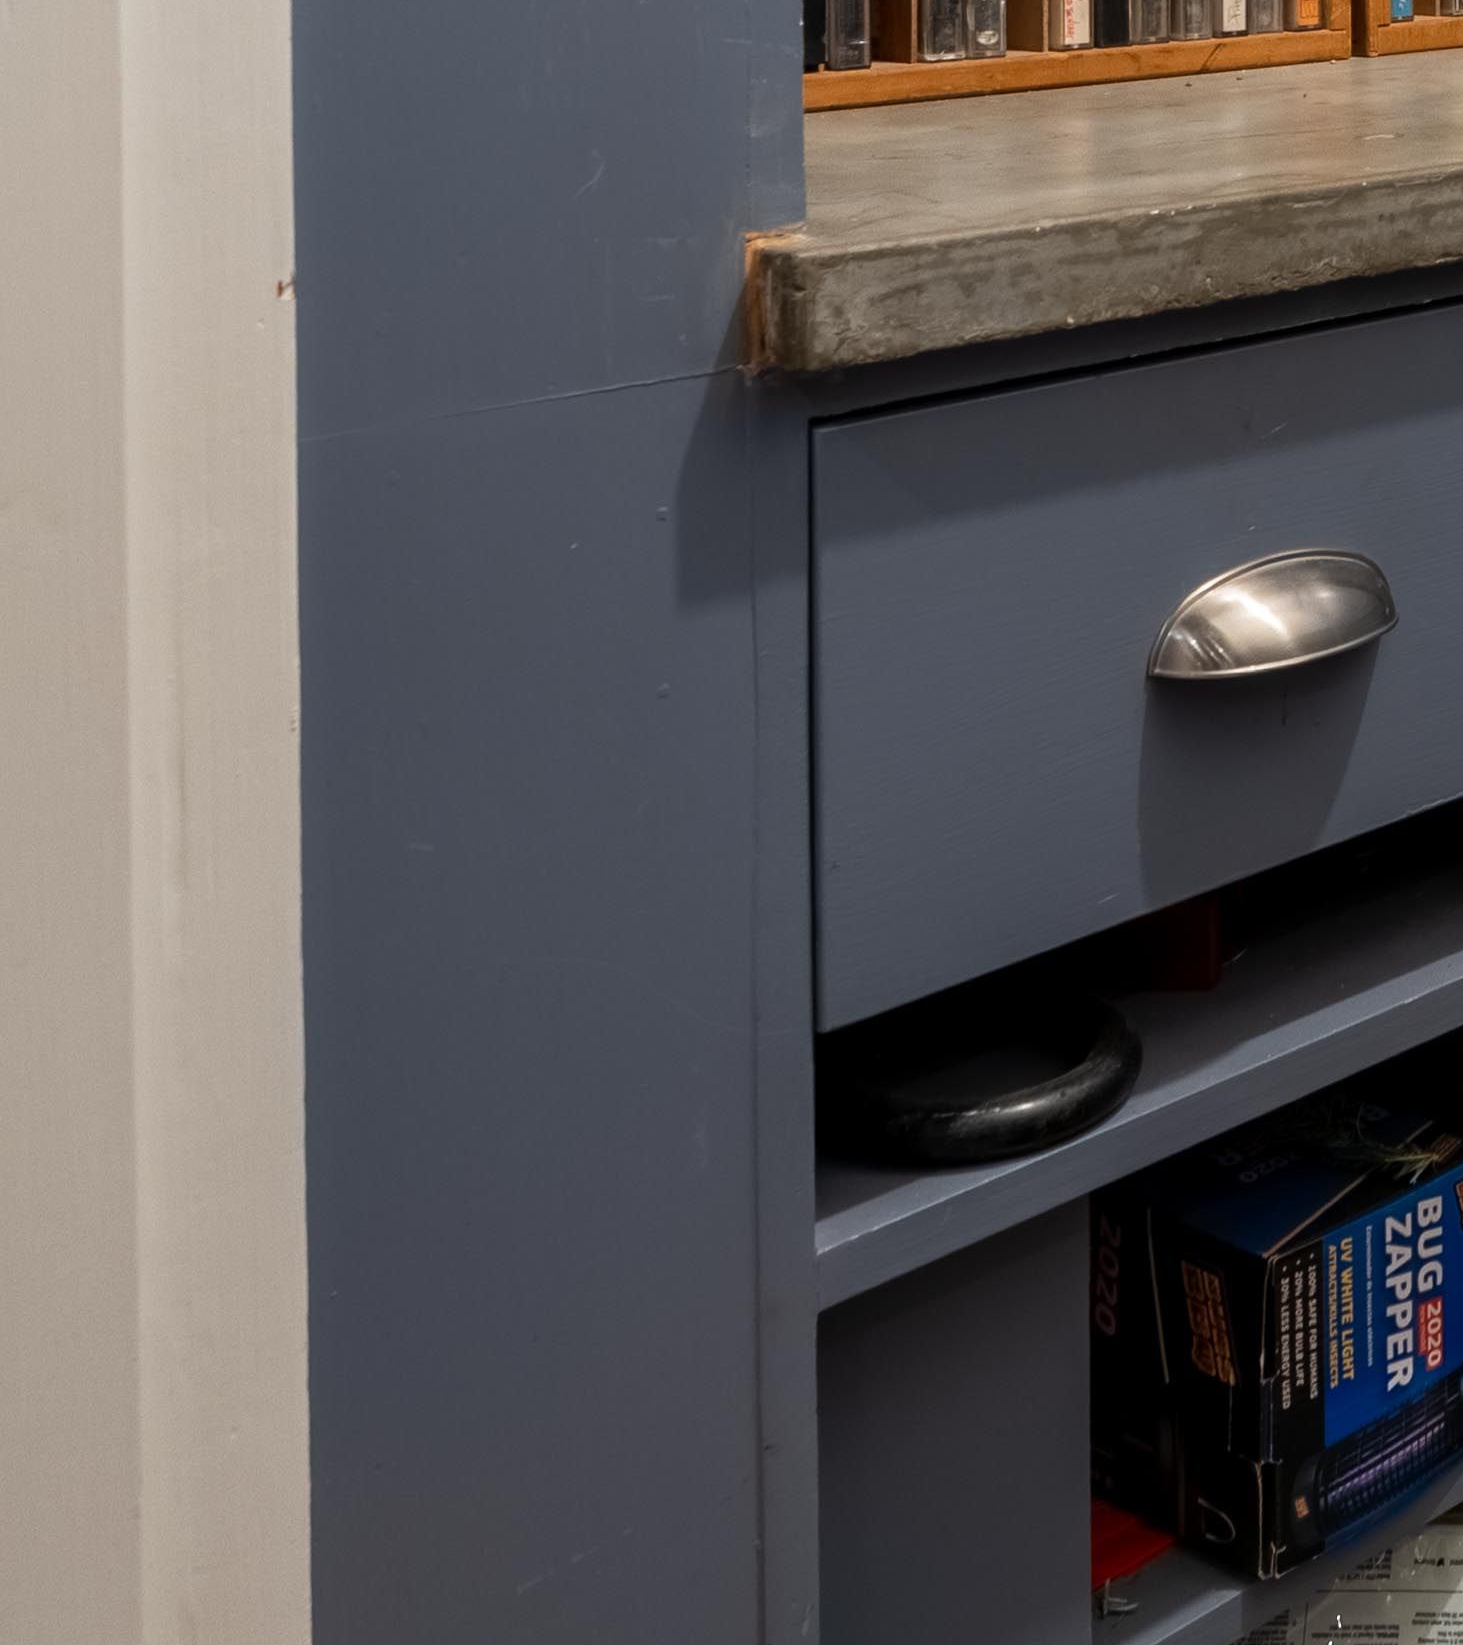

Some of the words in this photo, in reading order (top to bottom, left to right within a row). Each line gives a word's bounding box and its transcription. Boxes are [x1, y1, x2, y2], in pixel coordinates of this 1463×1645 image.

[1339, 1237, 1354, 1263] UV
[1416, 1195, 1443, 1293] BUG
[1280, 1276, 1290, 1304] 30%
[1293, 1270, 1304, 1296] 20%
[1306, 1264, 1317, 1297] 100%
[1327, 1244, 1338, 1338] ATTRACTS/KILLS
[1339, 1266, 1354, 1324] WHITE
[1294, 1298, 1304, 1330] MORE
[1307, 1298, 1317, 1326] SAFE
[1384, 1212, 1414, 1392] ZAPPER
[1280, 1305, 1290, 1332] LESS
[1426, 1299, 1442, 1368] 2020
[1294, 1331, 1304, 1361] BULB
[1308, 1328, 1317, 1350] FOR
[1341, 1329, 1355, 1381] LIGHT
[1280, 1334, 1291, 1377] ENERGY
[1329, 1339, 1339, 1389] INSECTS
[1295, 1362, 1305, 1387] LIFE
[1308, 1351, 1318, 1400] HUMANS
[1281, 1379, 1291, 1410] USED
